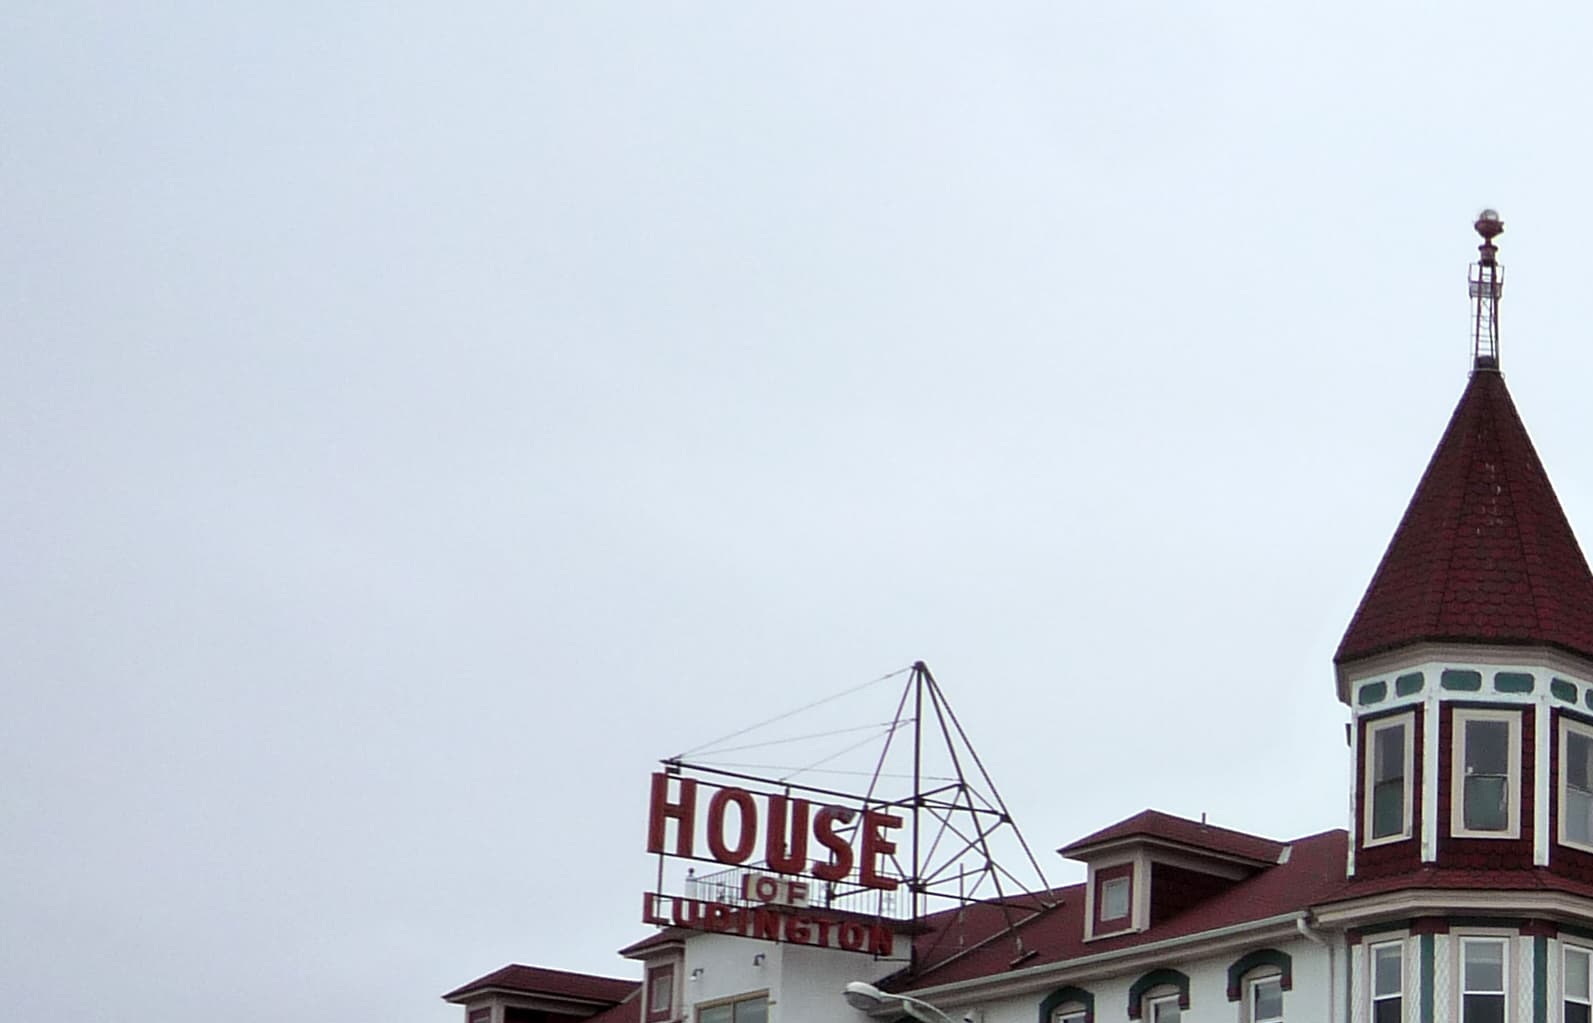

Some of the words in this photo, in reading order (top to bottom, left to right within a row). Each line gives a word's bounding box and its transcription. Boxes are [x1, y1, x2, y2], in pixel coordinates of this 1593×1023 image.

[647, 772, 903, 891] HOUSE
[756, 876, 810, 905] OF
[643, 892, 893, 956] LUDINGTON
